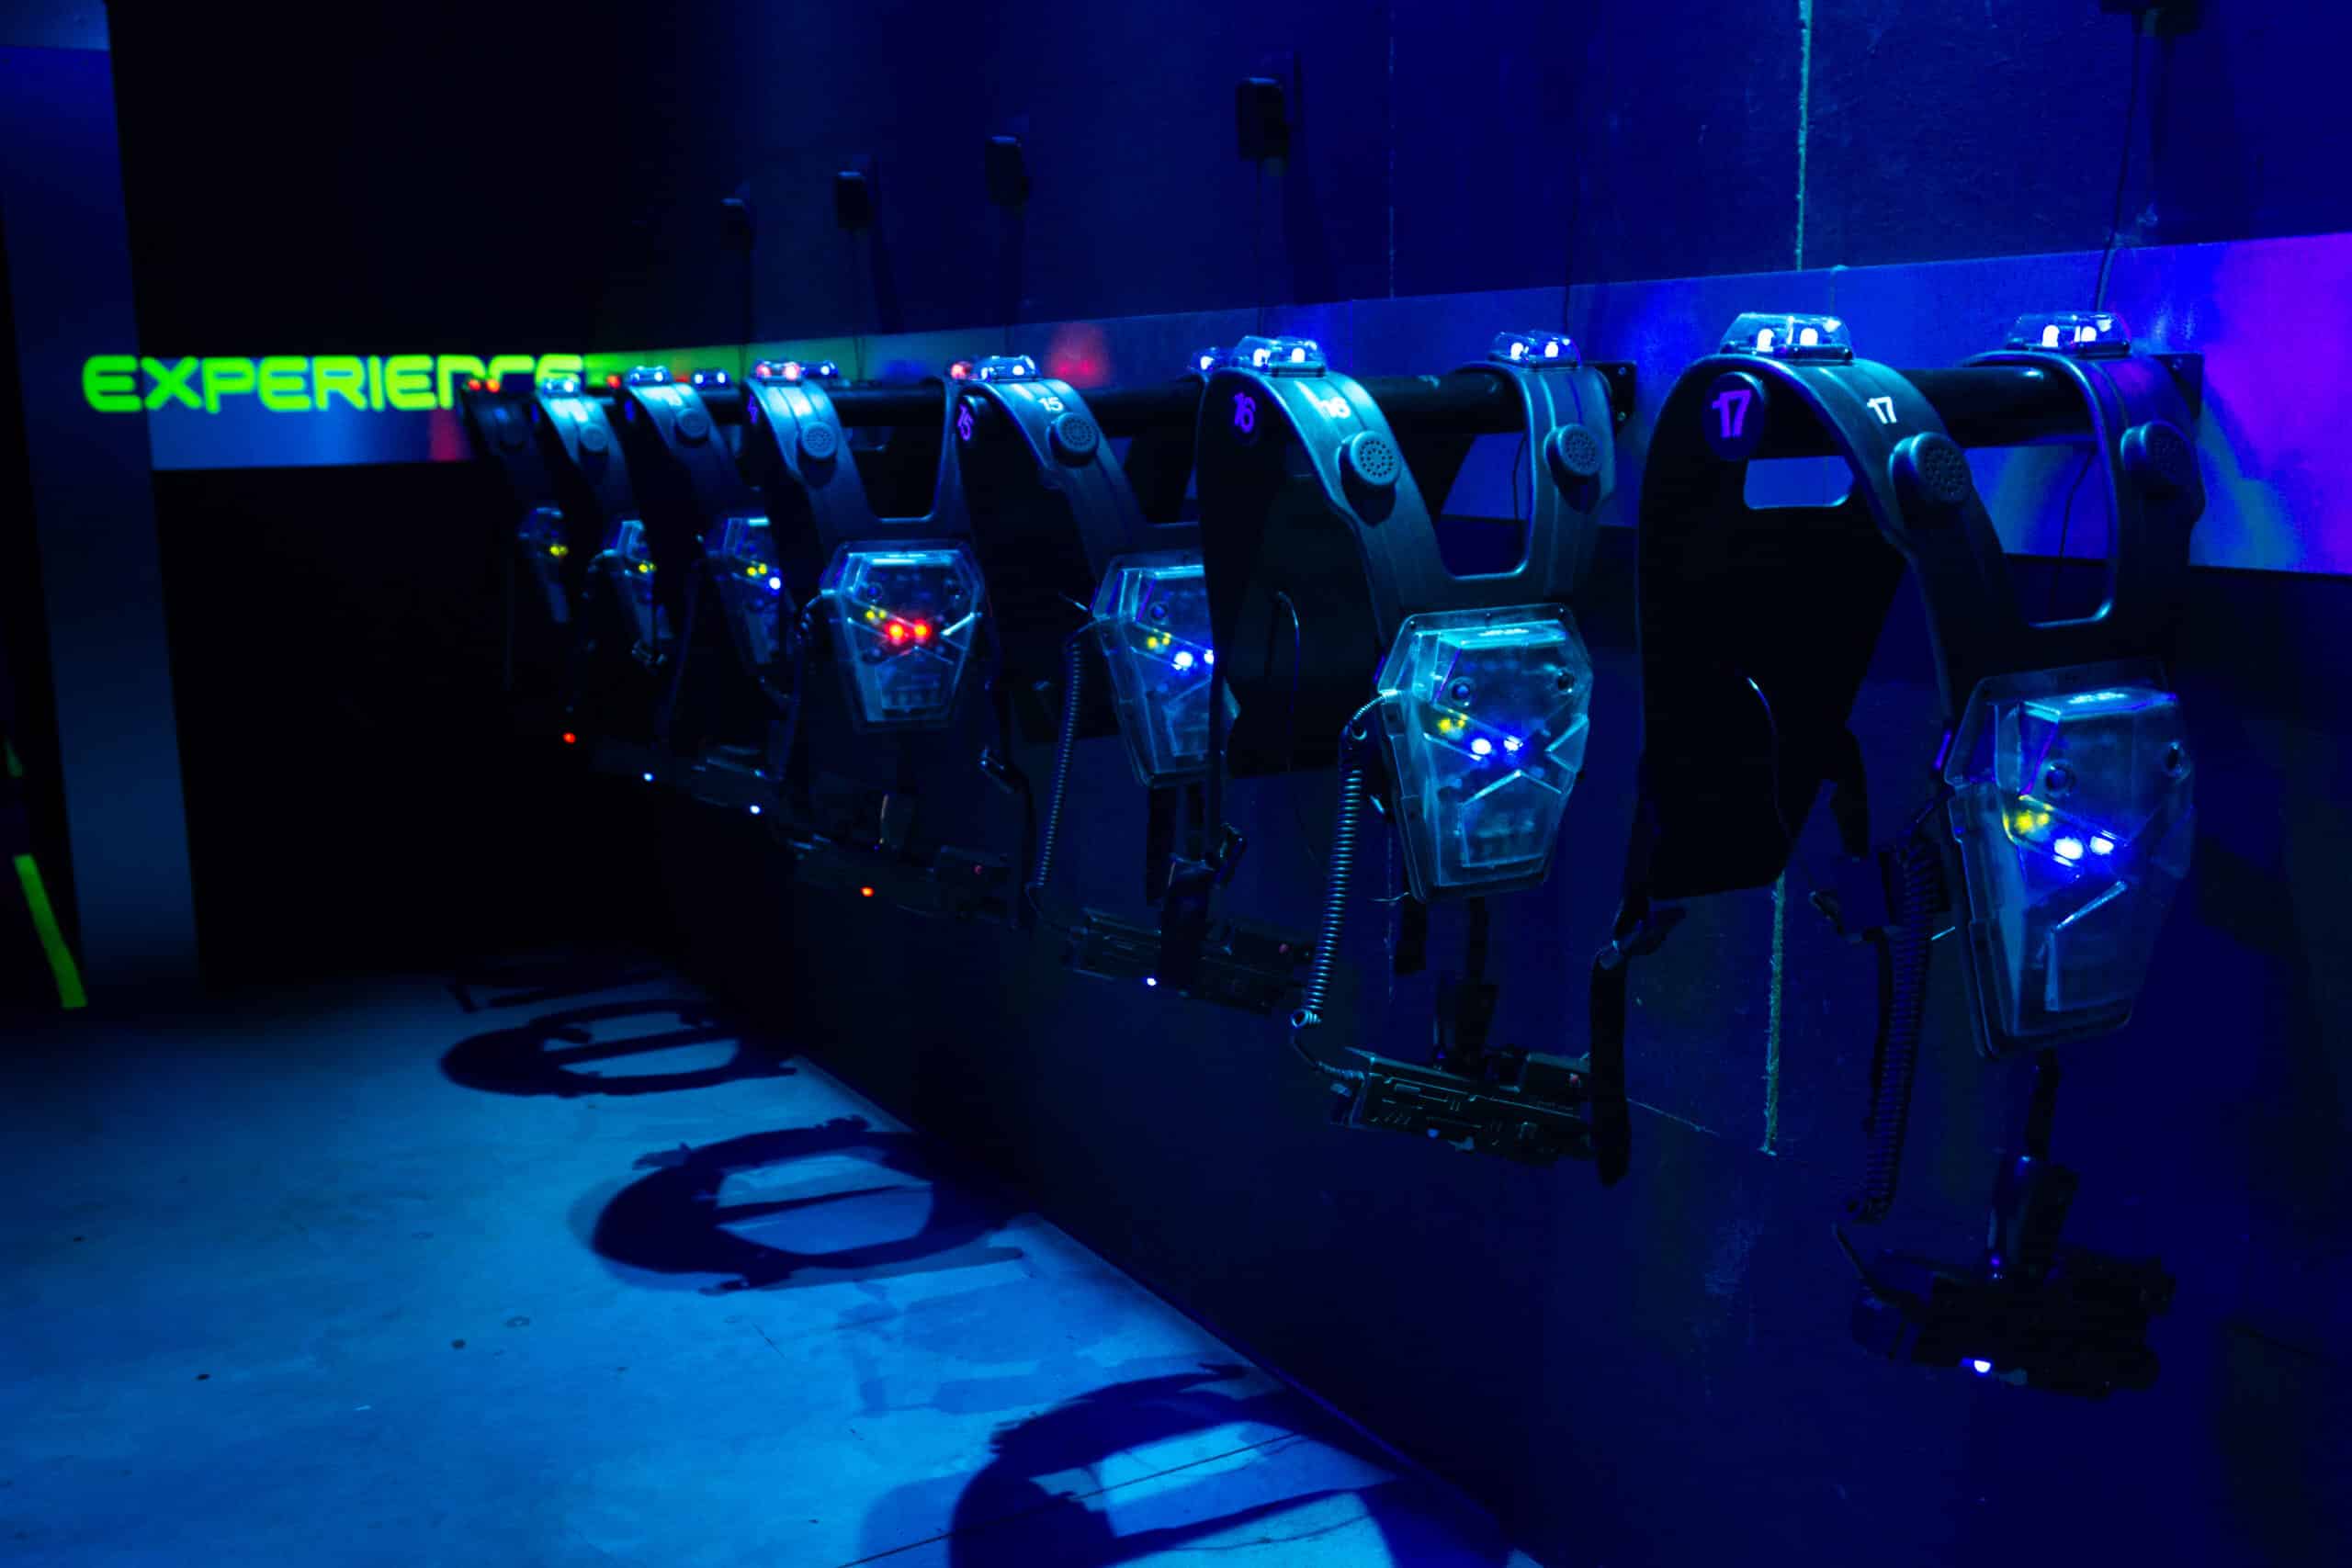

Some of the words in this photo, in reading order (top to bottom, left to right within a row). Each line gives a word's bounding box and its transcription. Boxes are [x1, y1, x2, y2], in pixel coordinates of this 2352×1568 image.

[1038, 396, 1064, 412] 15
[1233, 392, 1257, 434] 16
[1711, 389, 1752, 439] 17
[1866, 396, 1897, 424] 17
